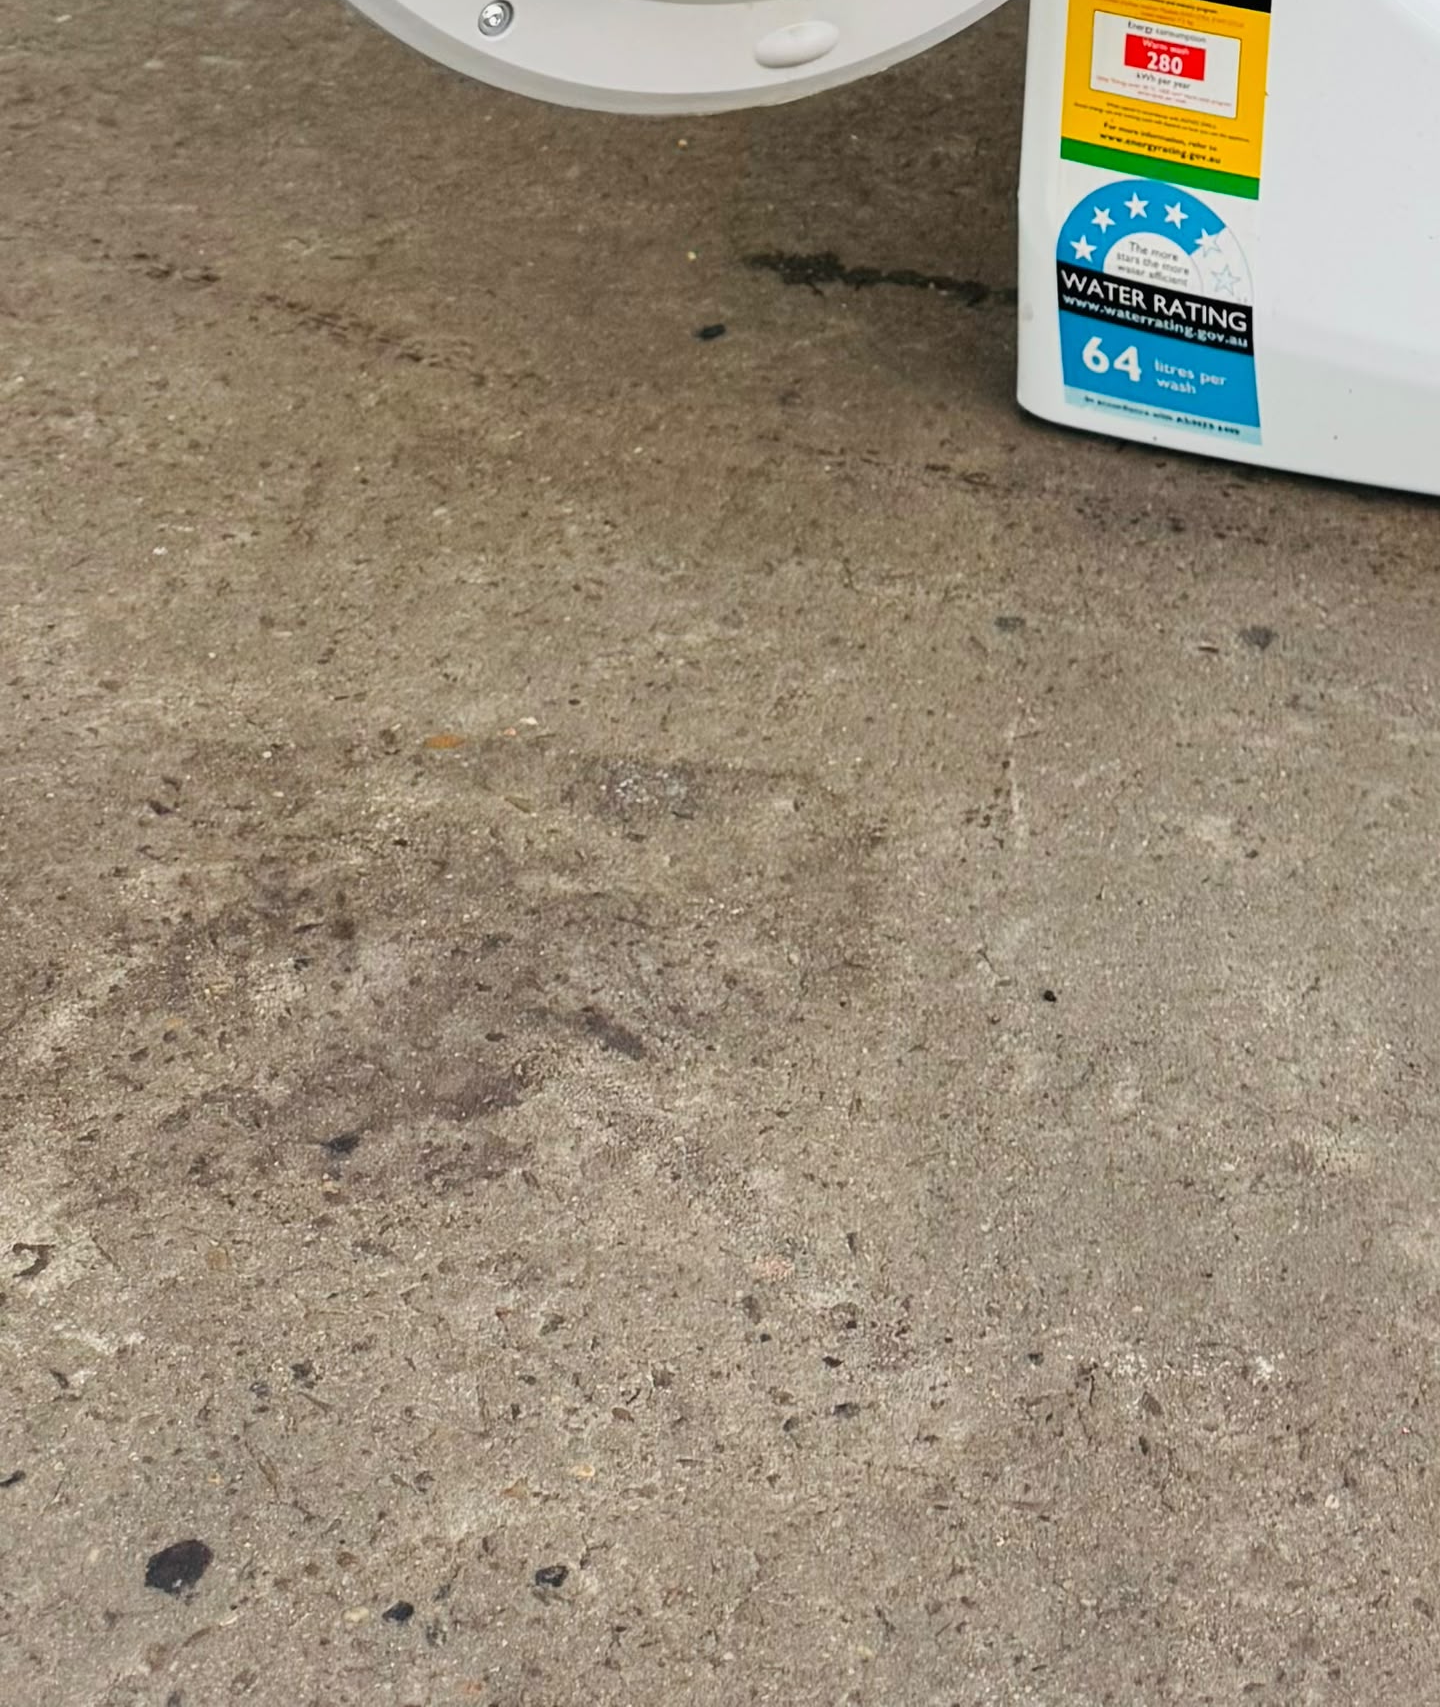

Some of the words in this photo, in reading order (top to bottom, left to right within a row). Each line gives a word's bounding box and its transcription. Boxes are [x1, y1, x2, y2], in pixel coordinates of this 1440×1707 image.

[1146, 51, 1184, 76] 280
[1136, 72, 1157, 83] kWh
[1157, 76, 1172, 87] per
[1173, 79, 1191, 90] year
[1118, 126, 1139, 137] more
[1099, 132, 1221, 165] www.energyrating.gov.au
[1116, 252, 1141, 266] stars
[1142, 257, 1160, 269] the
[1161, 262, 1190, 275] more
[1129, 241, 1147, 255] The
[1150, 249, 1179, 262] more
[1117, 265, 1145, 278] water
[1148, 270, 1188, 287] efficient
[1060, 269, 1147, 311] WATER
[1153, 293, 1248, 333] RATING
[1062, 294, 1249, 348] www.waterrating.gov.au
[1082, 336, 1142, 384] 64
[1154, 358, 1195, 380] litres
[1199, 372, 1228, 387] per
[1156, 377, 1197, 395] wash
